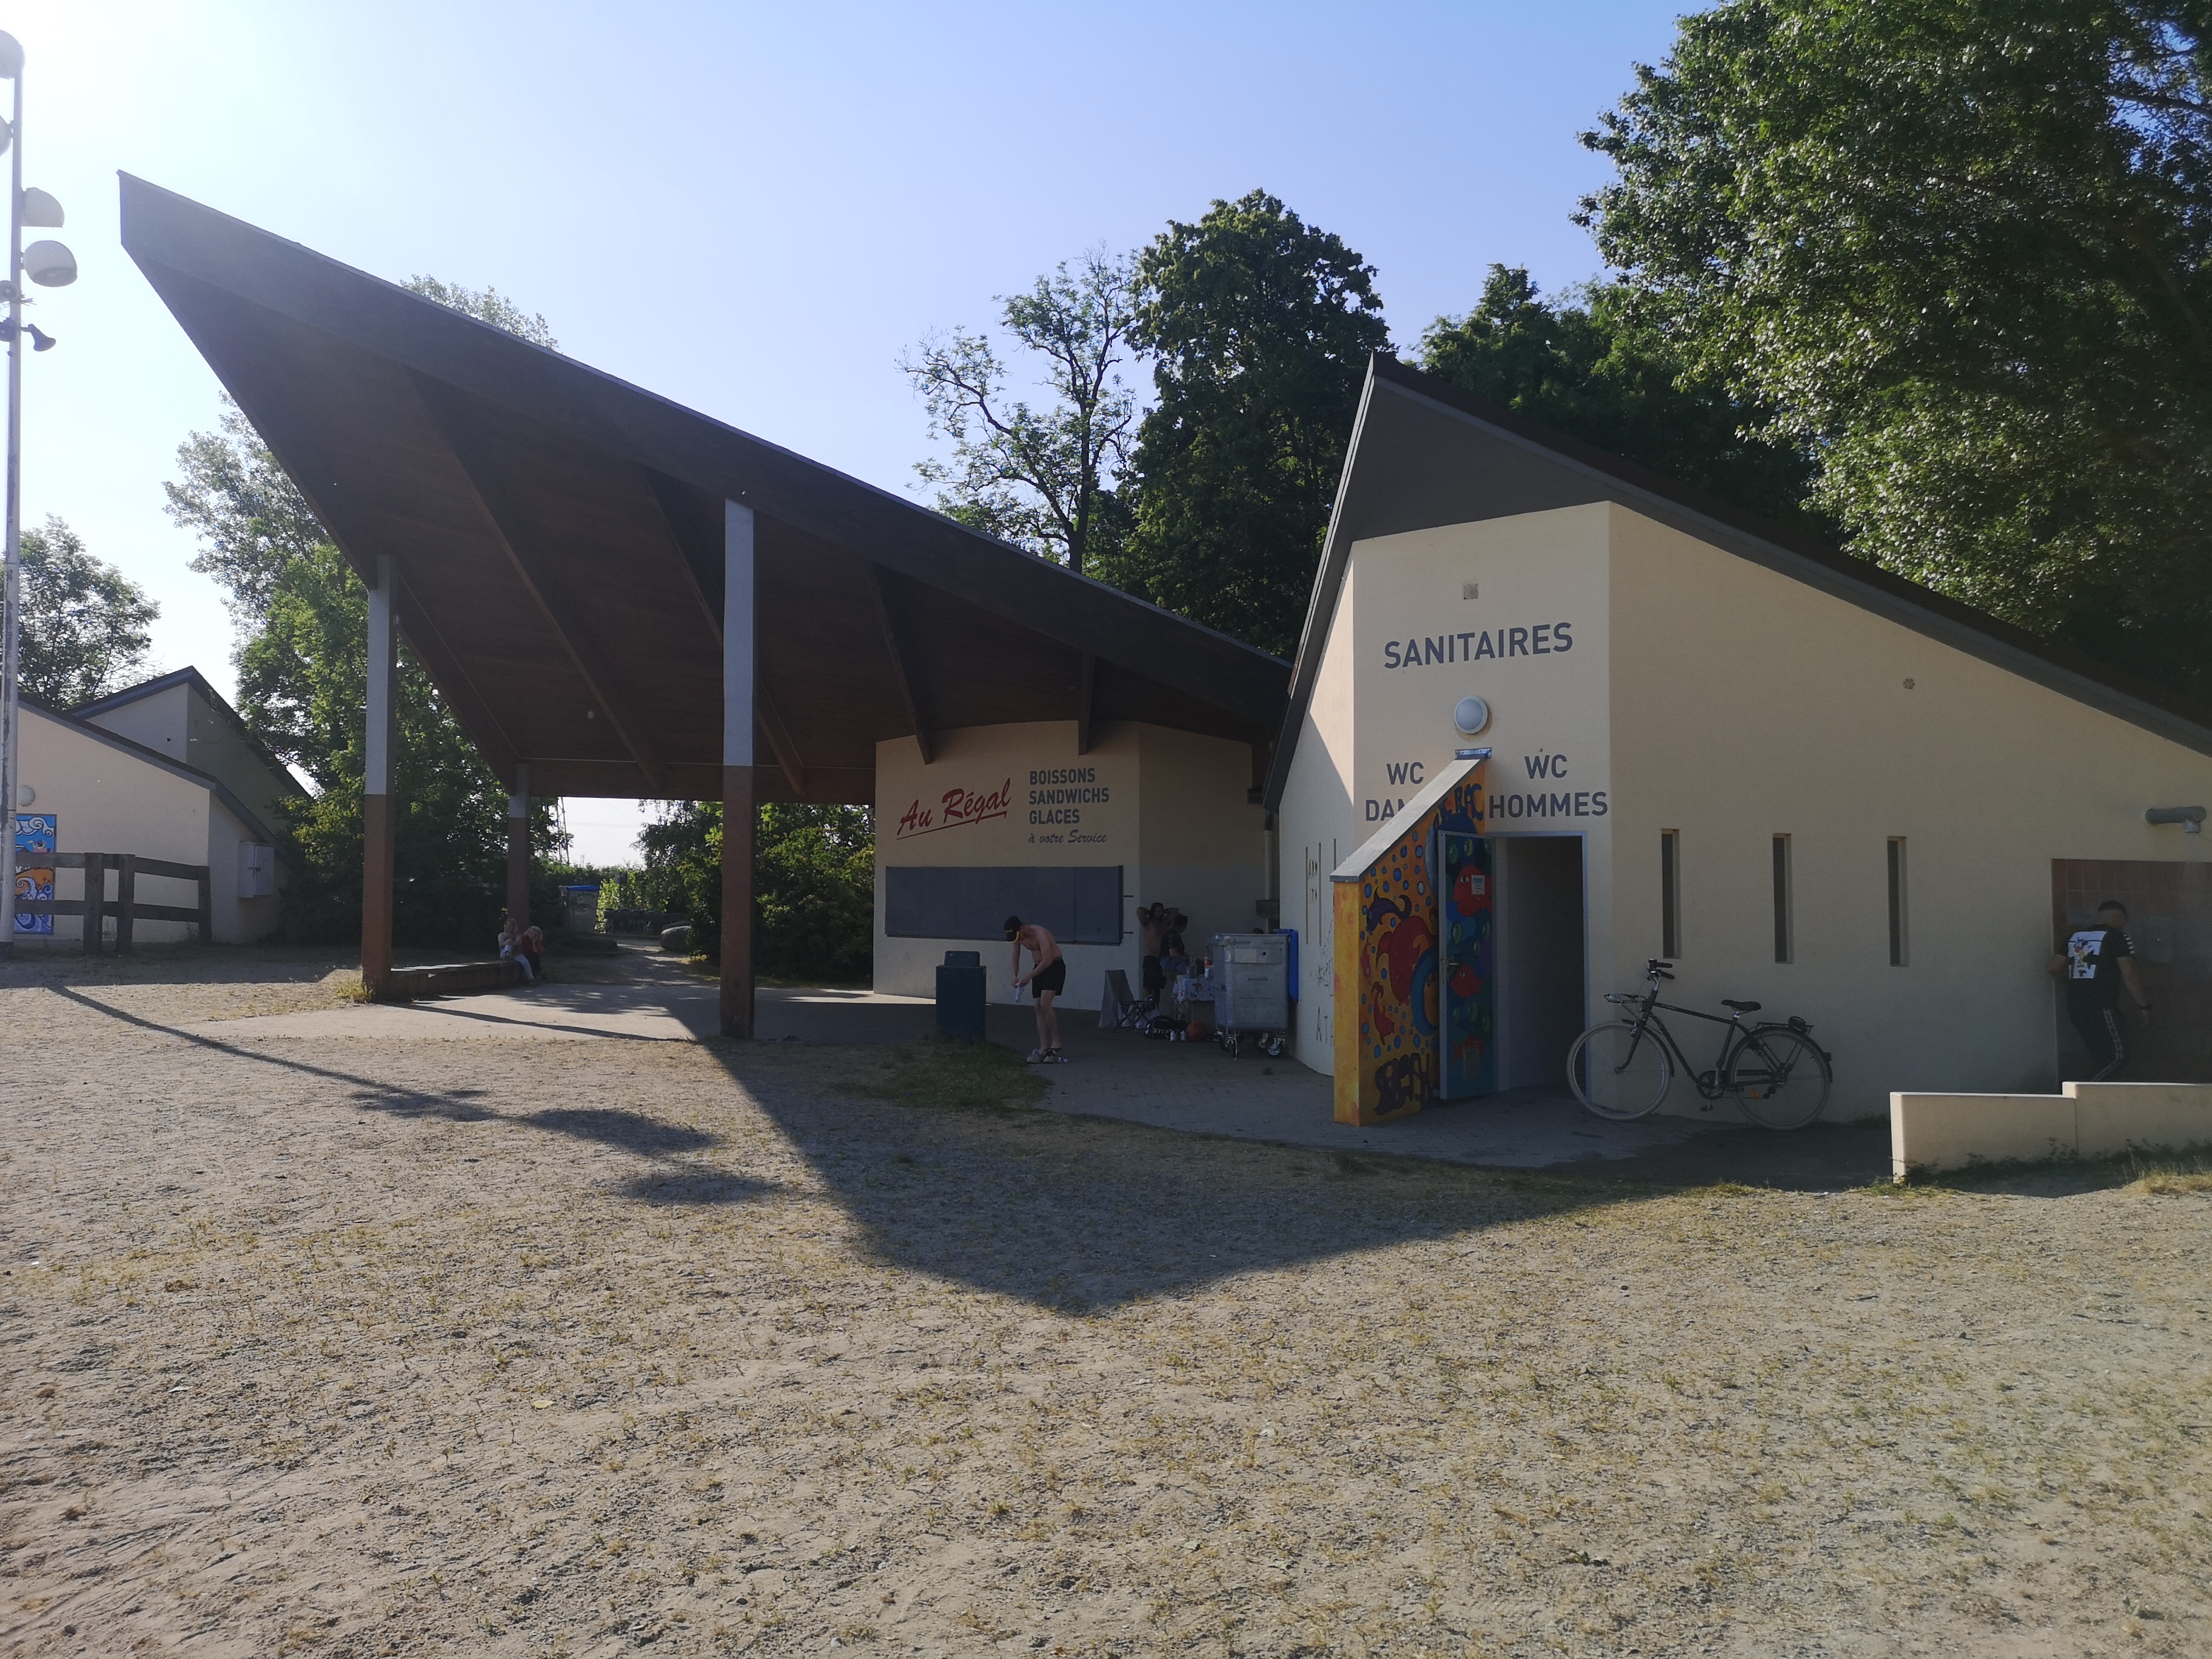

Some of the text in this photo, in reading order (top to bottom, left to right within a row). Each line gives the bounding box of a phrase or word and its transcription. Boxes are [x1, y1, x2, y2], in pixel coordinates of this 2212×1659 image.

[1384, 622, 1573, 669] SANITAIRES
[1030, 768, 1096, 786] BOISSONS
[1386, 762, 1424, 785] WC
[1524, 754, 1567, 779] WC
[897, 777, 1011, 836] Au Régal
[1029, 787, 1110, 805] SANDWICHS
[1489, 791, 1608, 819] HOMMES
[1029, 809, 1081, 825] GLACES
[1028, 830, 1107, 844] à votre Service
